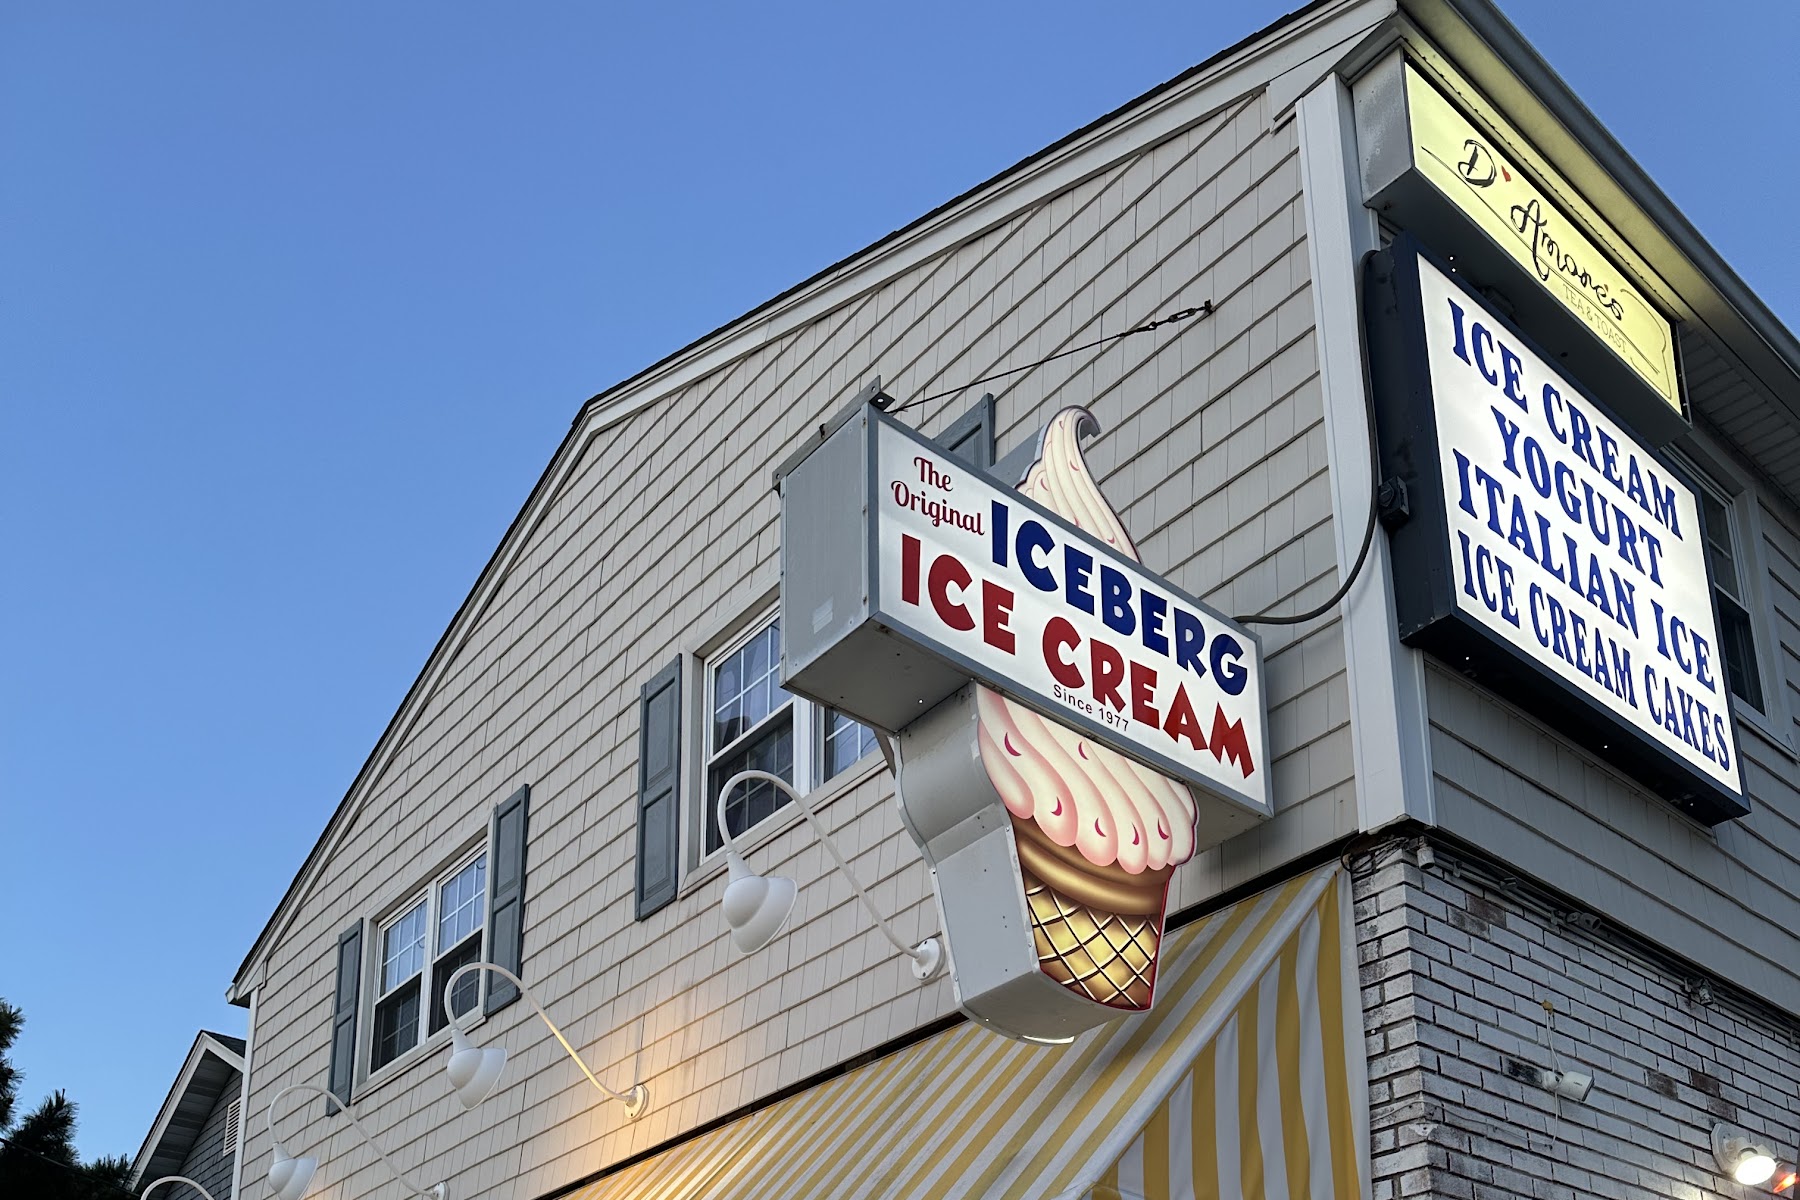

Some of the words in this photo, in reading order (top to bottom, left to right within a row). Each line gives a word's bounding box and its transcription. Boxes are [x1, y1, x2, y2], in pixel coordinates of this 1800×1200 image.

[1563, 283, 1585, 314] TEA
[1586, 306, 1593, 322] &
[1594, 313, 1627, 353] TOAST
[891, 480, 985, 536] Original
[914, 456, 954, 492] The
[1447, 298, 1528, 414] ICE
[1542, 383, 1684, 541] CREAM
[1491, 405, 1665, 590] YOGURT
[901, 533, 1016, 656] ICE
[1042, 616, 1255, 779] CREAM
[991, 499, 1248, 696] ICEBERG
[1452, 448, 1639, 639] ITALIAN
[1651, 599, 1716, 693] ICE
[1457, 530, 1520, 629] ICE
[1529, 582, 1639, 710] CREAM
[1644, 664, 1730, 771] CAKES
[1053, 684, 1093, 715] Since
[1099, 706, 1129, 731] 1977
